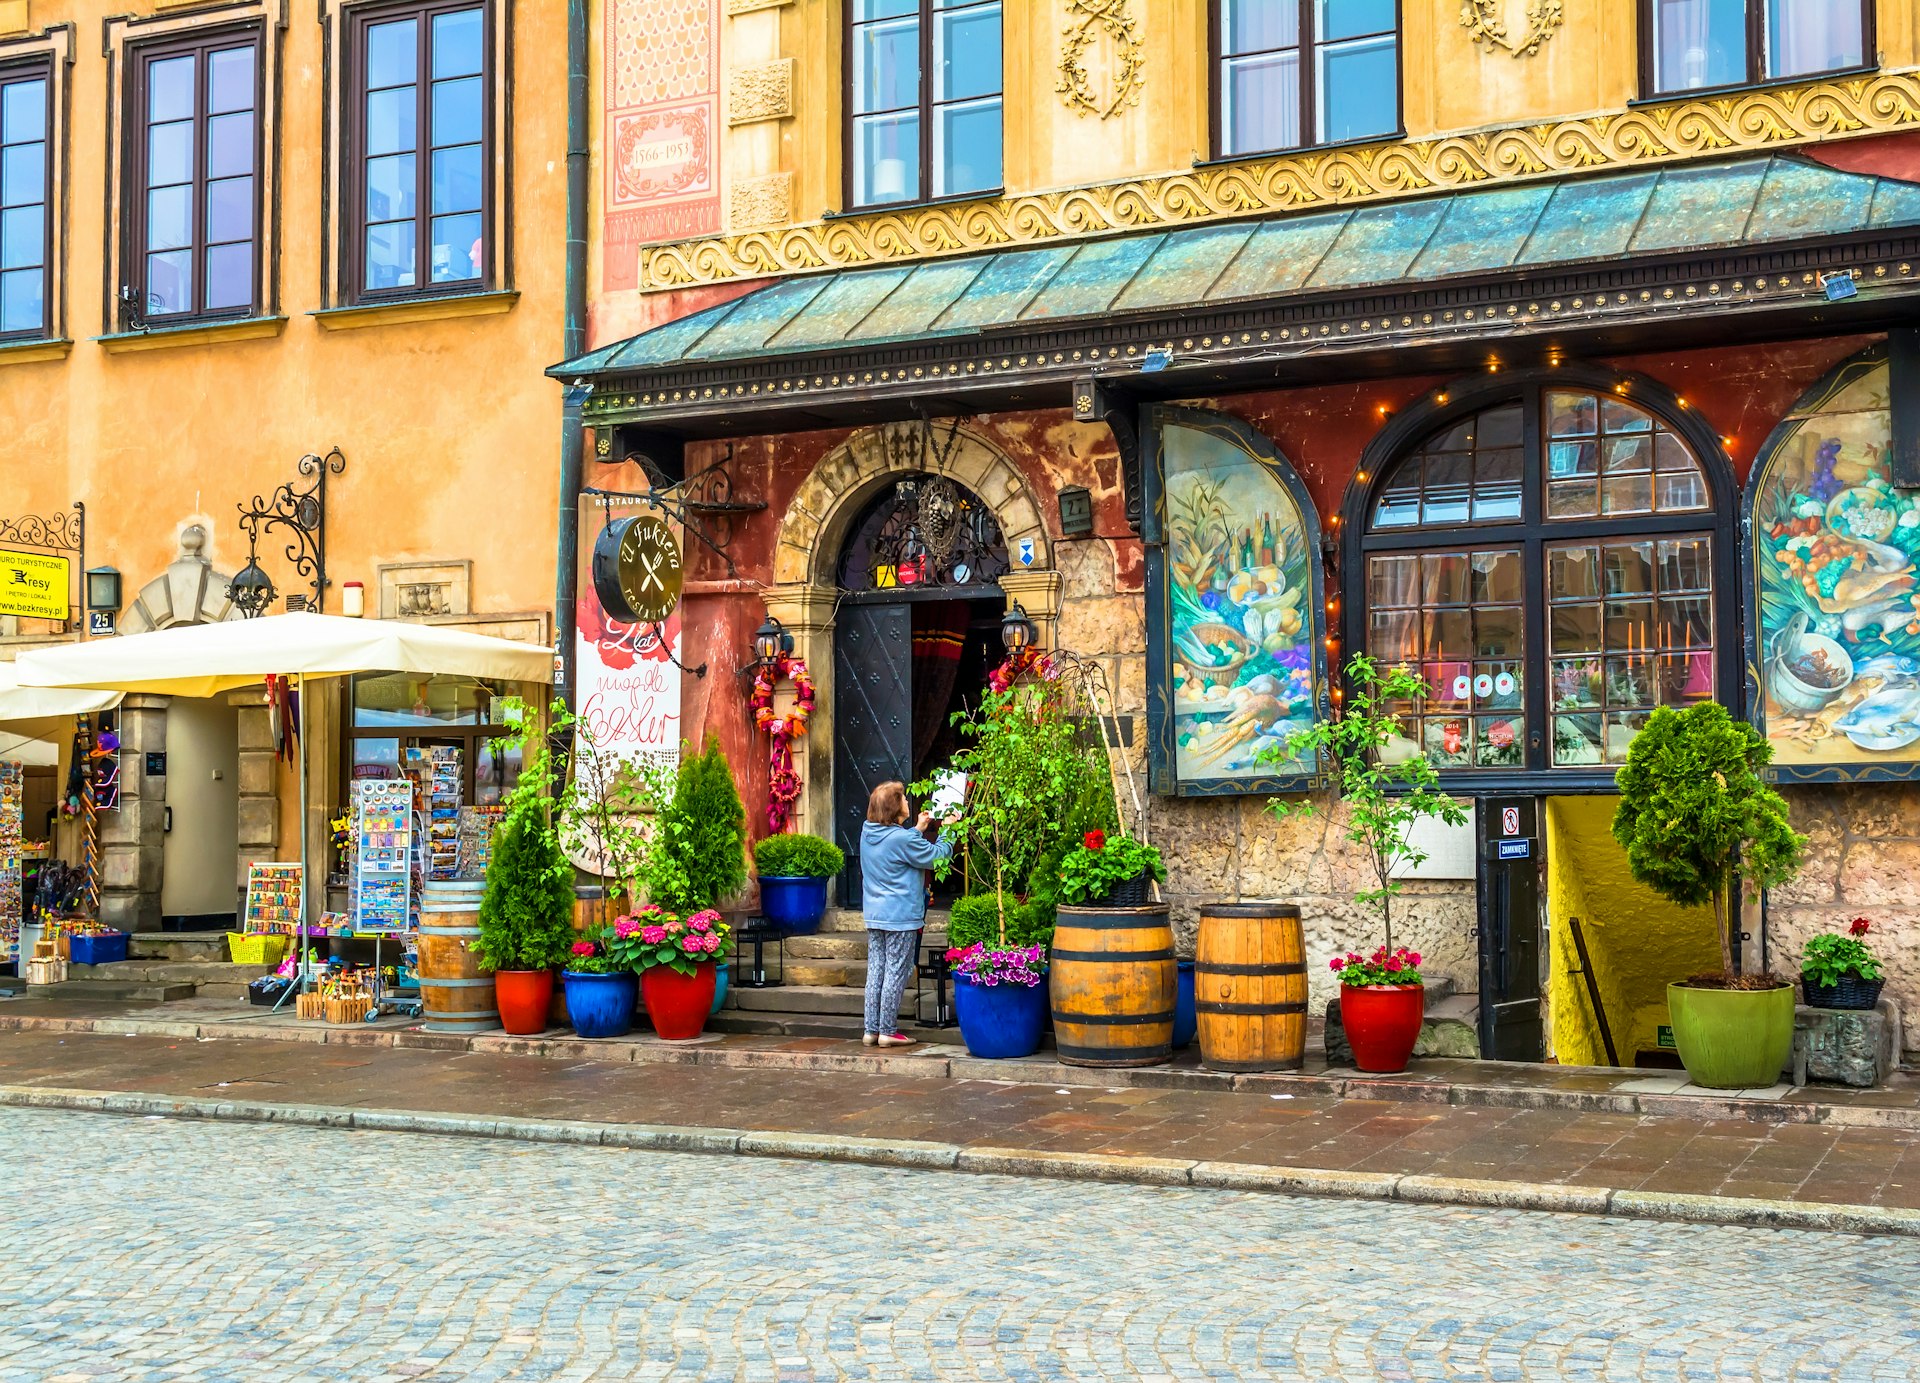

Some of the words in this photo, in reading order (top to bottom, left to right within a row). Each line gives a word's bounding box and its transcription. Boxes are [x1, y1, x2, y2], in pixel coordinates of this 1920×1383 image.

[635, 142, 690, 165] 1566-1953
[595, 495, 667, 507] RESTAURA
[621, 542, 635, 563] U
[634, 521, 680, 570] Fukiera
[17, 557, 63, 570] TURYSTYCZNE
[0, 602, 63, 616] ww.bezkresy.pl
[625, 587, 678, 620] restaurant
[95, 613, 109, 628] 25
[633, 632, 656, 650] lat
